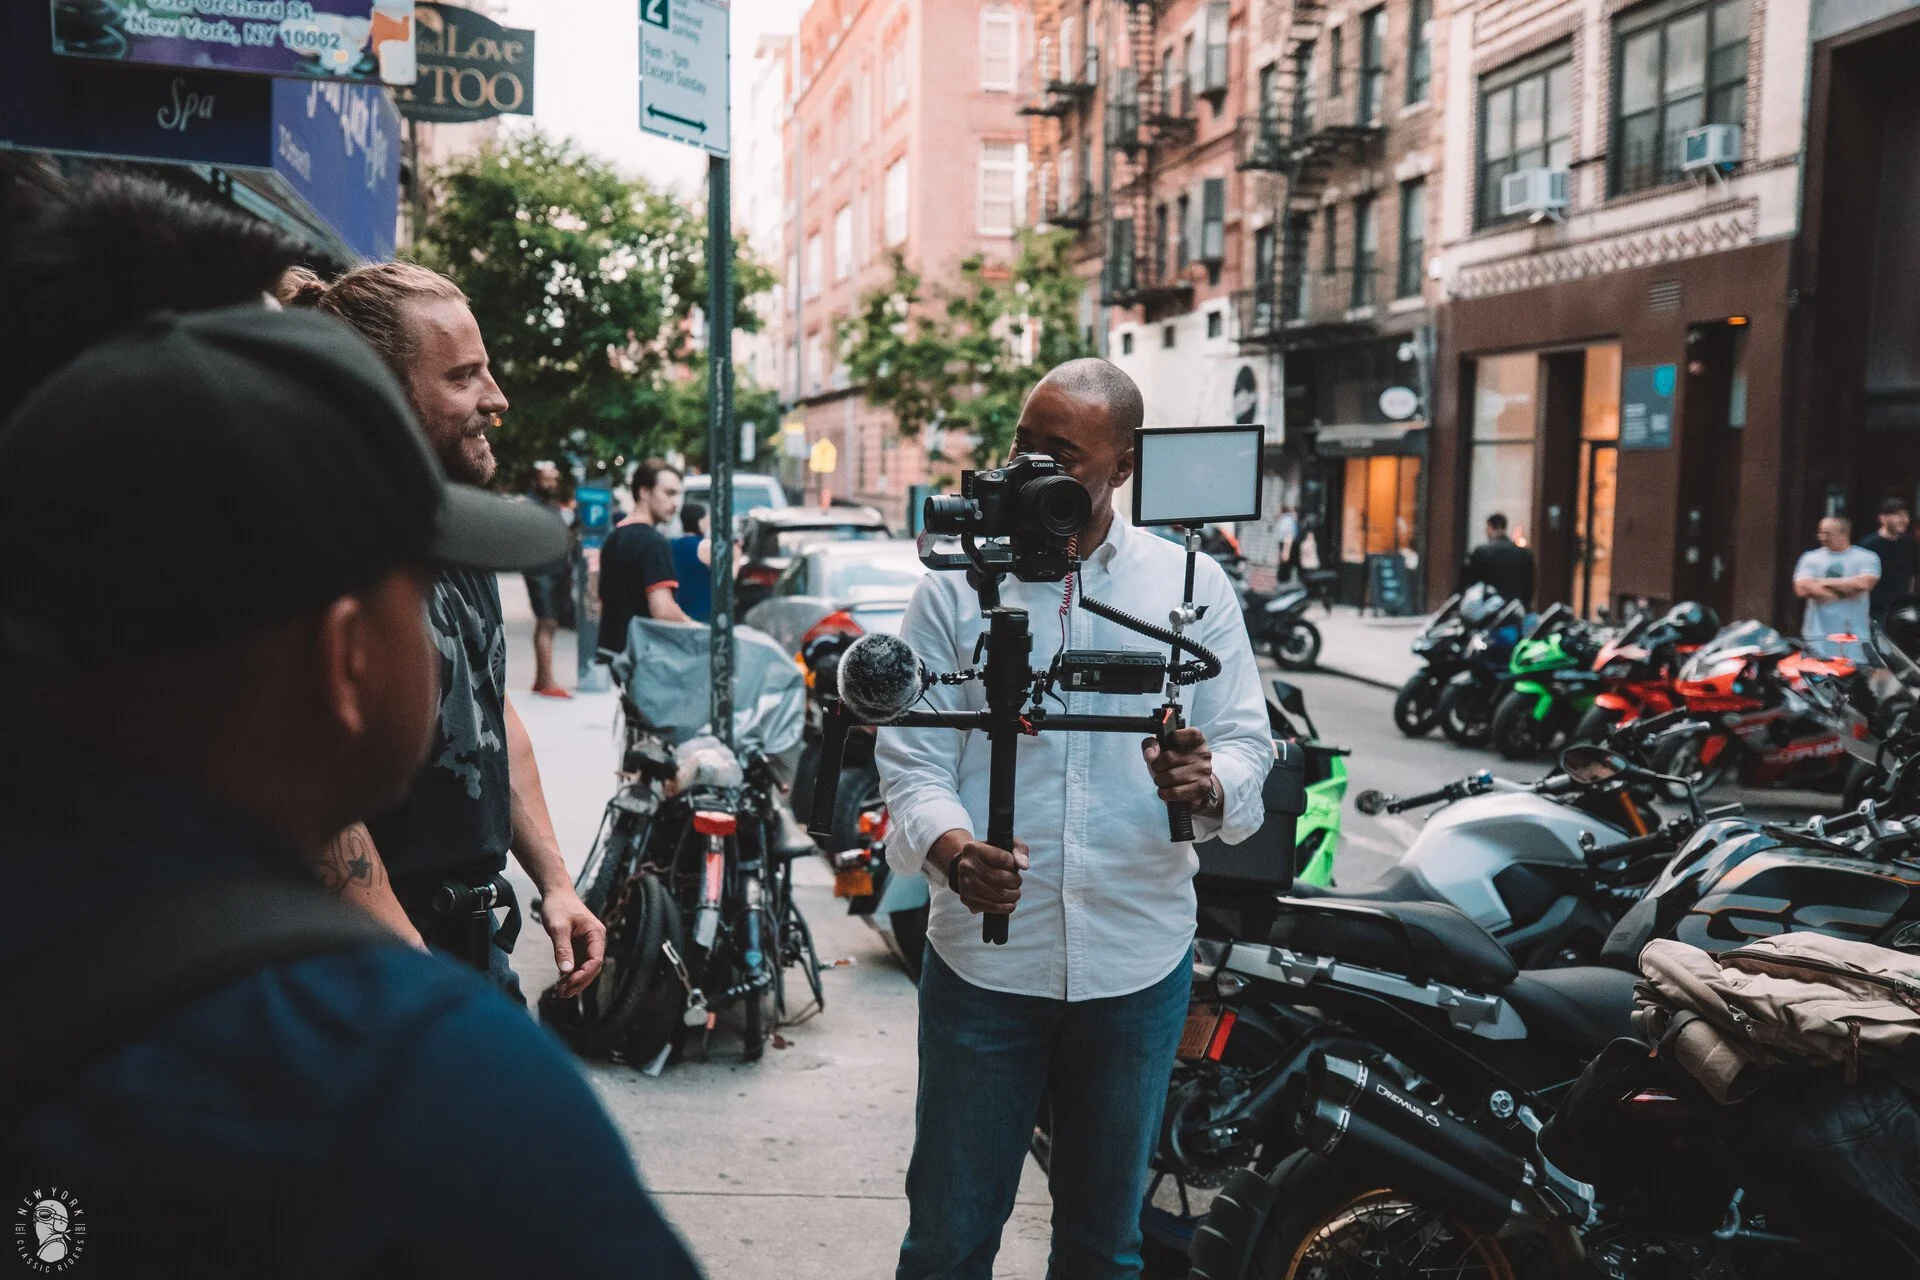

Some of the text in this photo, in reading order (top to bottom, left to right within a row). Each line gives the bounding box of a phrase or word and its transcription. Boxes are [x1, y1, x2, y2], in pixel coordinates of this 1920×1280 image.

[129, 15, 178, 36] New
[244, 22, 277, 45] NY
[282, 30, 341, 49] 10002
[447, 24, 525, 64] Love
[157, 77, 216, 131] Spa
